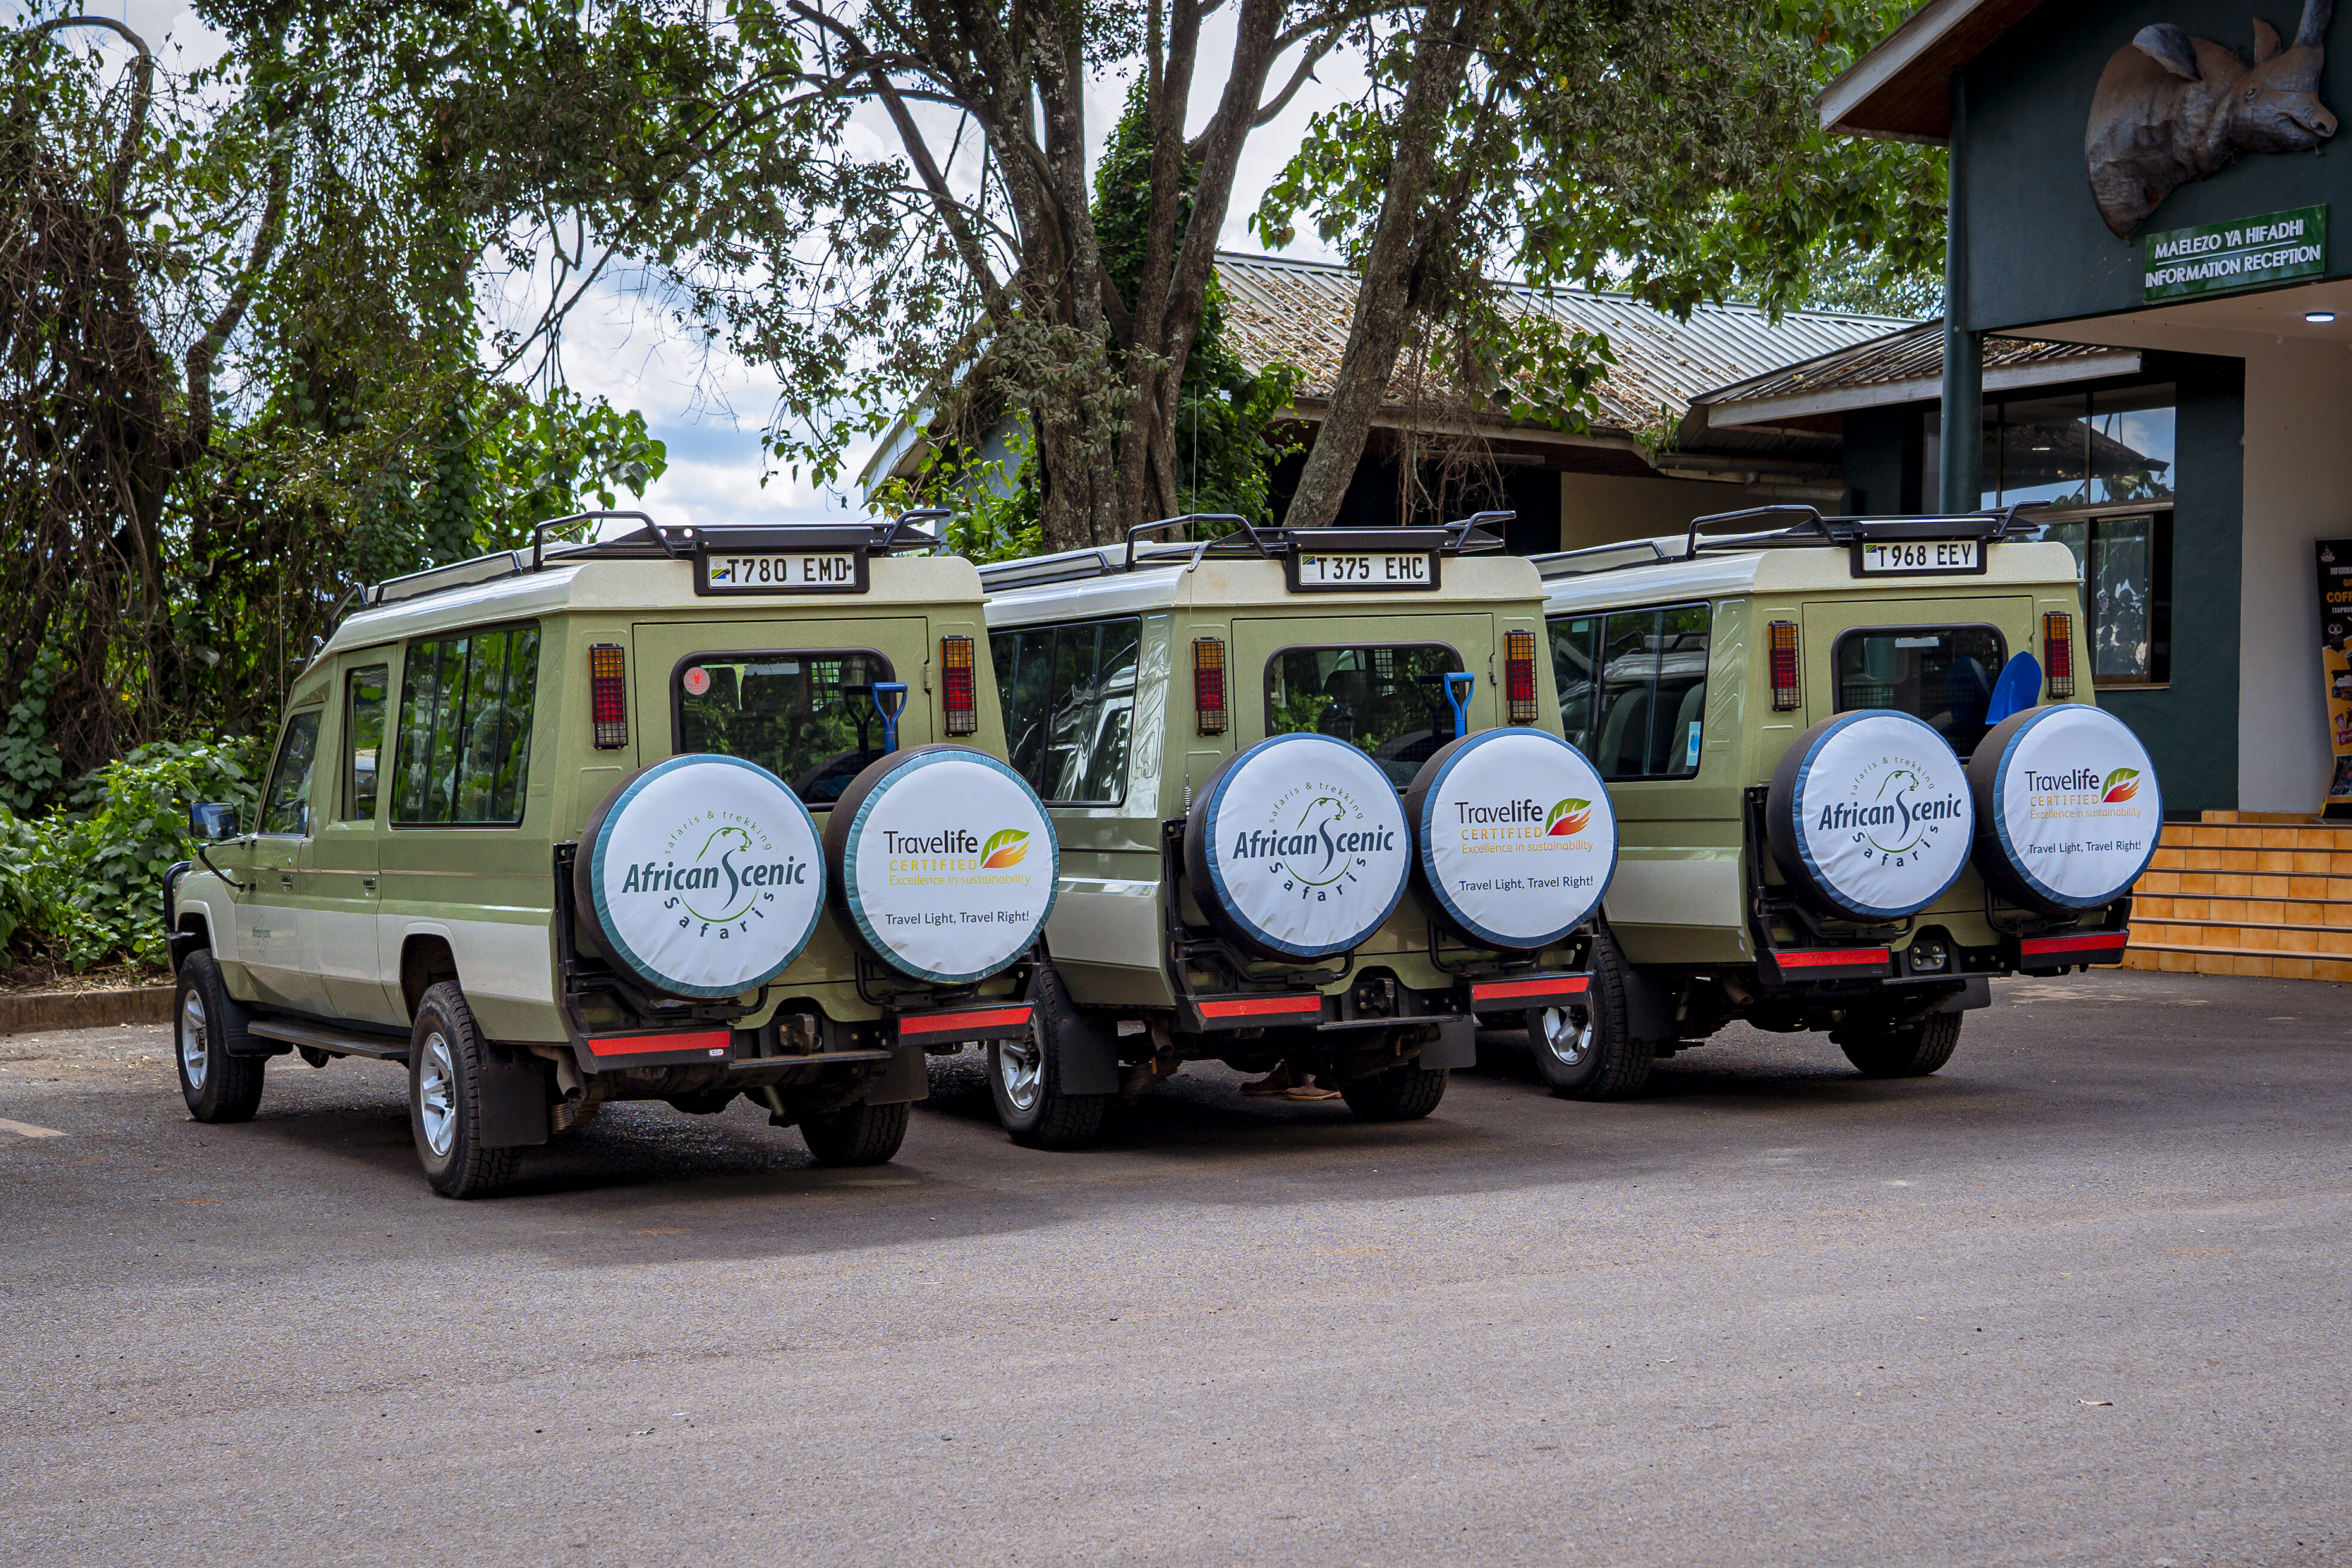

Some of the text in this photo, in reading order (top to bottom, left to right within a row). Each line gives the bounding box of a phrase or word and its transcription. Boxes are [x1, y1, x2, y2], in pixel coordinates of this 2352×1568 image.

[2155, 219, 2304, 259] MAELEZO YA HIFADHI
[2145, 245, 2321, 288] INFORMATION RECEPTION
[1937, 543, 1971, 565] EEY
[727, 557, 847, 583] T780 EMD
[1385, 557, 1424, 579] EHC
[1851, 761, 1877, 796] safaris
[1895, 757, 1935, 790] trekking
[2025, 768, 2100, 792] Travelife
[1270, 782, 1363, 823] safaris & trekking
[1454, 799, 1543, 824] Travelife
[2031, 794, 2099, 807] CERTIFIED
[2031, 807, 2142, 819] Excellence in sustainability
[664, 810, 772, 855] safaris & trekking
[883, 829, 978, 854] Travelife
[1461, 827, 1542, 840] CERTIFIED
[1462, 840, 1594, 854] Excellence in sustainability
[2029, 840, 2142, 854] Travel Light, Travel Right!
[889, 859, 977, 871] CERTIFIED
[889, 874, 1030, 886] Excellence in sustainability
[1459, 875, 1593, 892] Travel Light, Travel Right!
[886, 911, 1029, 926] Travel Light, Travel Right!
